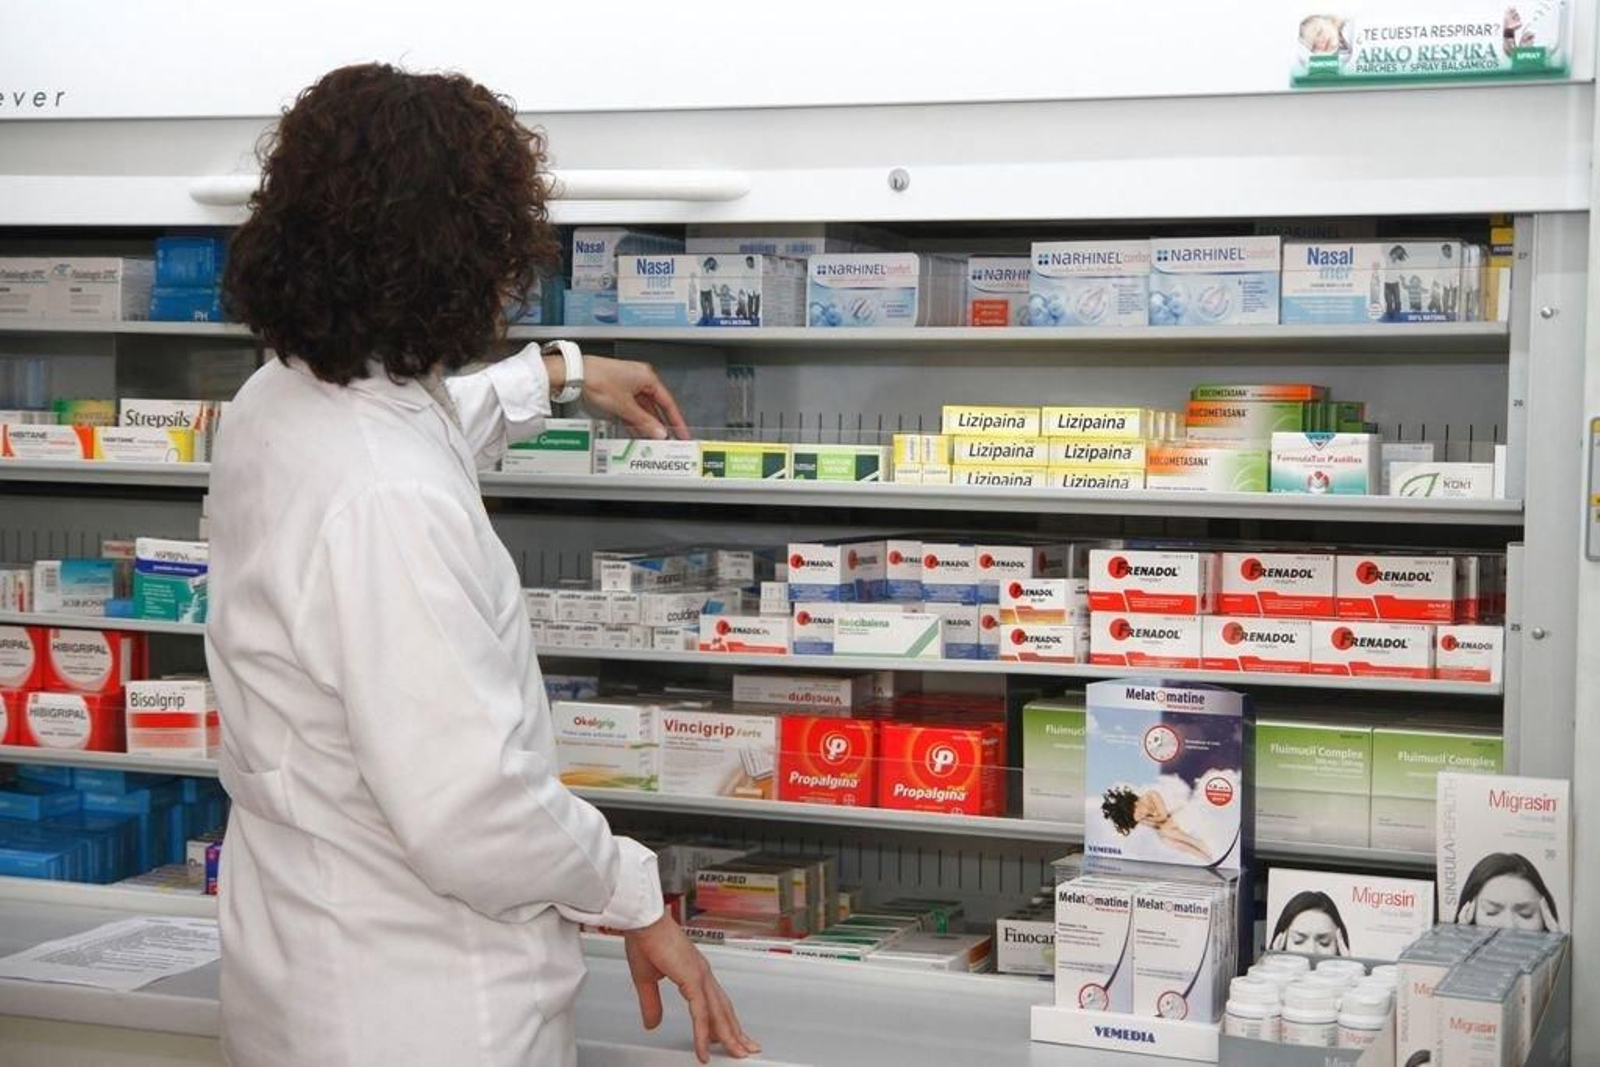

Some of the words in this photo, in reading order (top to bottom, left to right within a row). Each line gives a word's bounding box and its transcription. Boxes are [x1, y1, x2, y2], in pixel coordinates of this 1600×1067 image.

[1381, 27, 1428, 43] CUESTA
[1431, 24, 1500, 41] RESPIRAR?
[1357, 45, 1412, 63] ARKO
[1418, 42, 1498, 60] RESPIRA
[1356, 62, 1397, 73] PARCHES
[1410, 61, 1440, 72] SPRAY
[575, 240, 605, 255] Nasal
[1307, 246, 1354, 265] Nasal
[637, 257, 675, 275] Nasal
[125, 408, 190, 429] Strepsils
[958, 413, 1026, 431] Lizipaina
[1058, 413, 1126, 432] Lizipaina
[969, 443, 1035, 461] Lizipaina
[1065, 444, 1132, 463] Lizipaina
[630, 460, 690, 472] FARINGESIC
[1115, 560, 1179, 577] FRENADOL
[1250, 563, 1314, 579] FRENADOL
[1365, 566, 1432, 582] FRENADOL
[1117, 622, 1181, 639] FRENADOL
[1230, 627, 1296, 643] FRENADOL
[53, 642, 108, 655] HIBIGRIPAL
[1340, 633, 1408, 649] FRENADOL
[130, 690, 186, 712] Bisolgrip
[29, 707, 87, 720] HIBIGRIPAL
[663, 719, 735, 738] Vincigrip
[1270, 743, 1316, 757] Fluimucil
[1318, 746, 1363, 760] Complex
[1398, 751, 1446, 765] Fluimucil
[1447, 754, 1496, 768] Complex
[789, 770, 859, 789] Propalgina
[893, 783, 967, 804] Propalgina
[1488, 789, 1556, 814] Migrasin
[1088, 844, 1122, 856] VEMEDIA
[698, 874, 747, 885] AERO-RED
[1352, 886, 1415, 909] Migrasin
[1094, 1024, 1156, 1045] VEMEDIA
[1449, 1016, 1496, 1035] Migrasin
